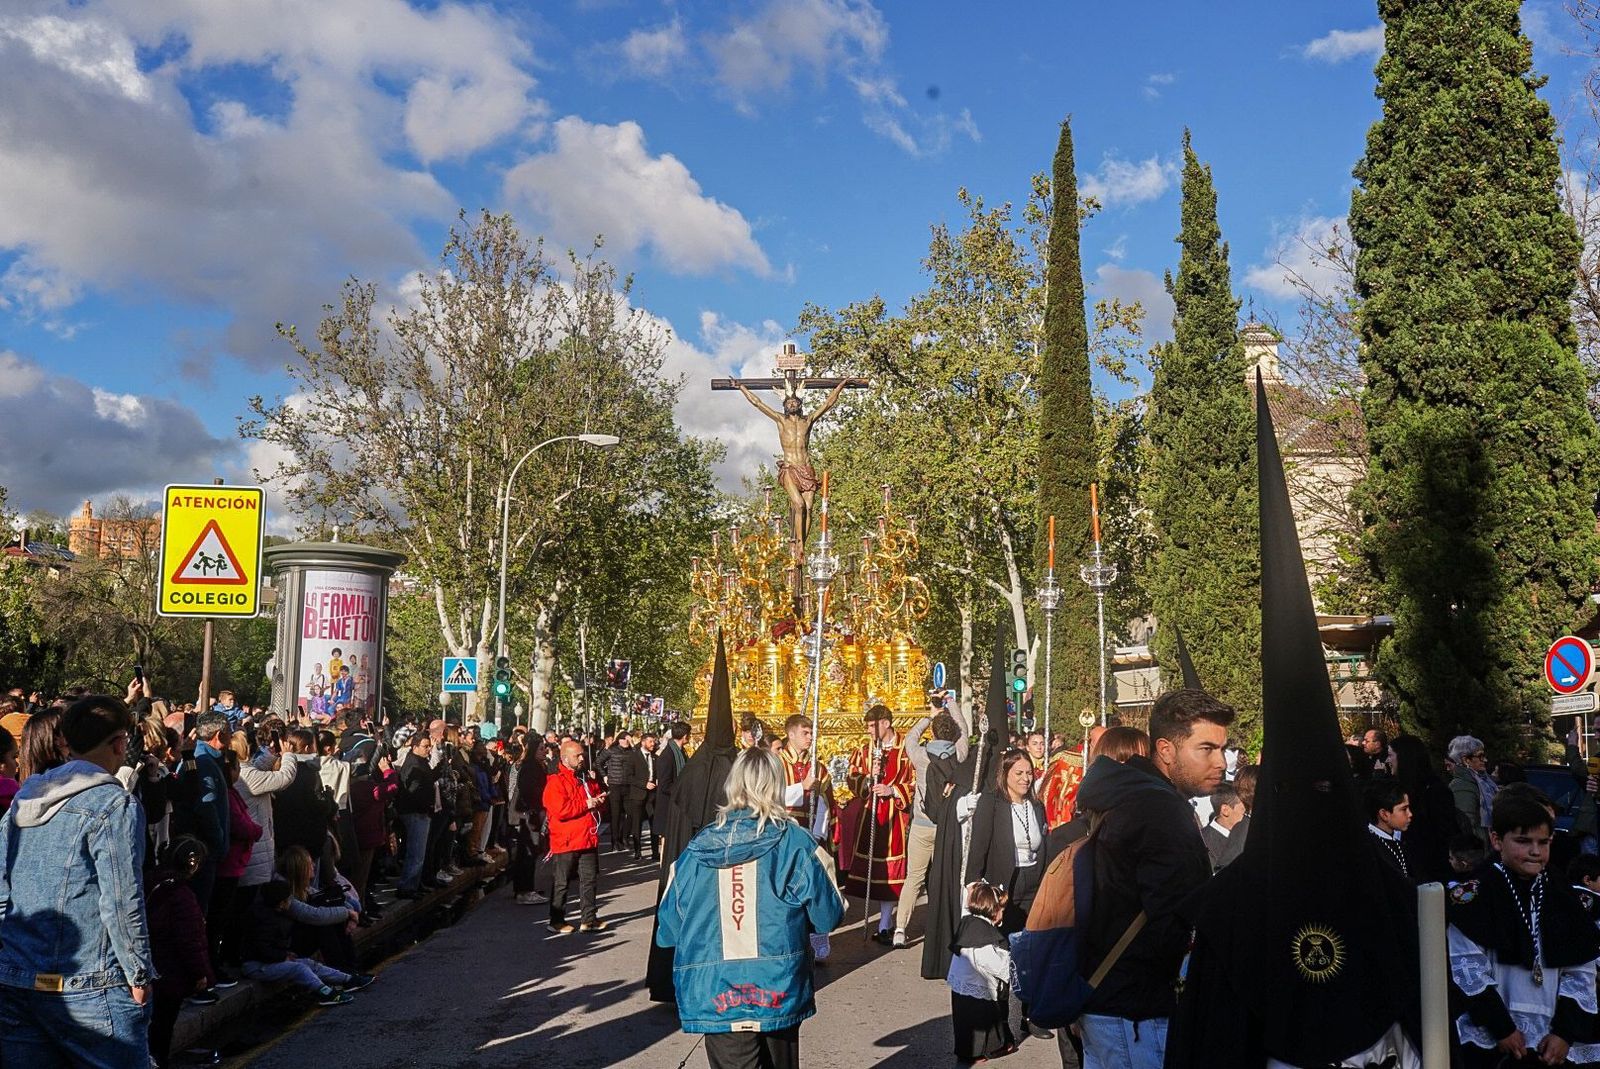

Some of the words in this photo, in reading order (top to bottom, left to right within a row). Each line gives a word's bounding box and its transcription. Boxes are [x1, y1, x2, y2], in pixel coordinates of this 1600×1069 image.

[172, 496, 257, 510] ATENCIÓN
[169, 592, 248, 605] COLEGIO
[305, 592, 317, 608] LA
[319, 593, 378, 618] FAMILIA
